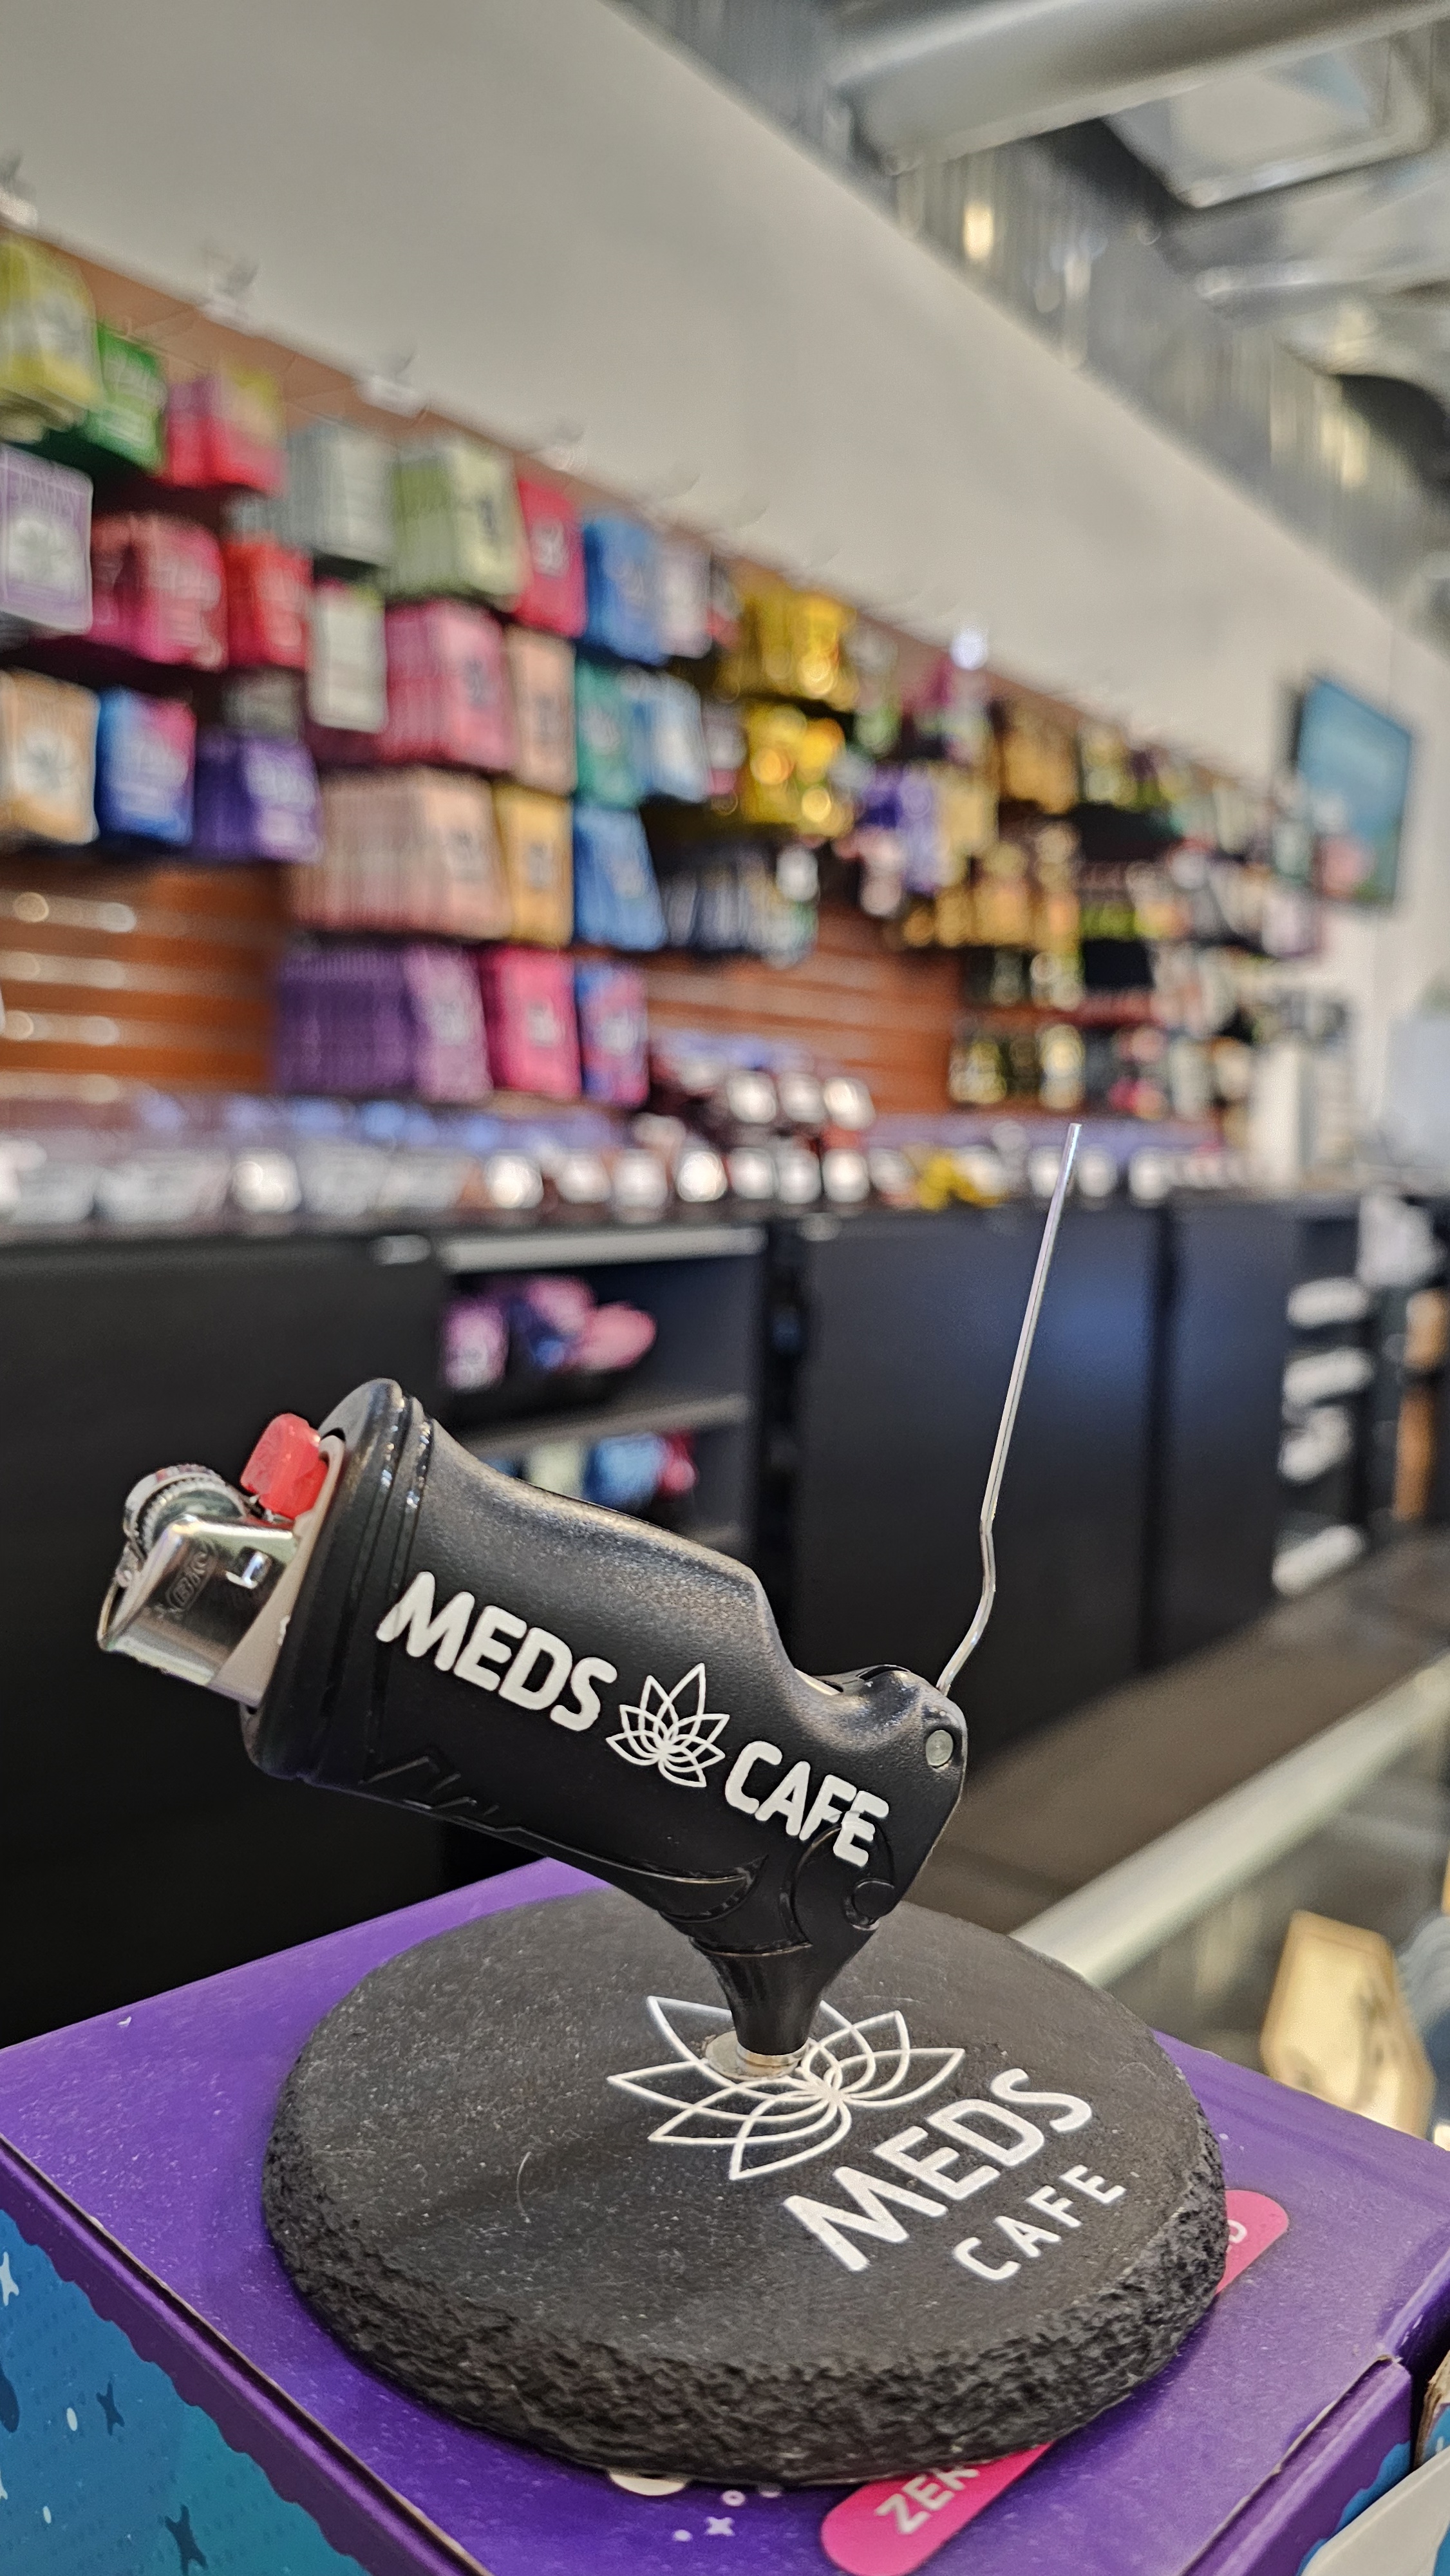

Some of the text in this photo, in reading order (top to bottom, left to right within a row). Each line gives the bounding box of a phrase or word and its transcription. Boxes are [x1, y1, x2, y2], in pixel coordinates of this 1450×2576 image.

[172, 1550, 210, 1608] BIC
[376, 1571, 889, 1867] MEDS CAFE
[782, 2068, 1093, 2272] MEDS
[951, 2164, 1127, 2282] CAFE
